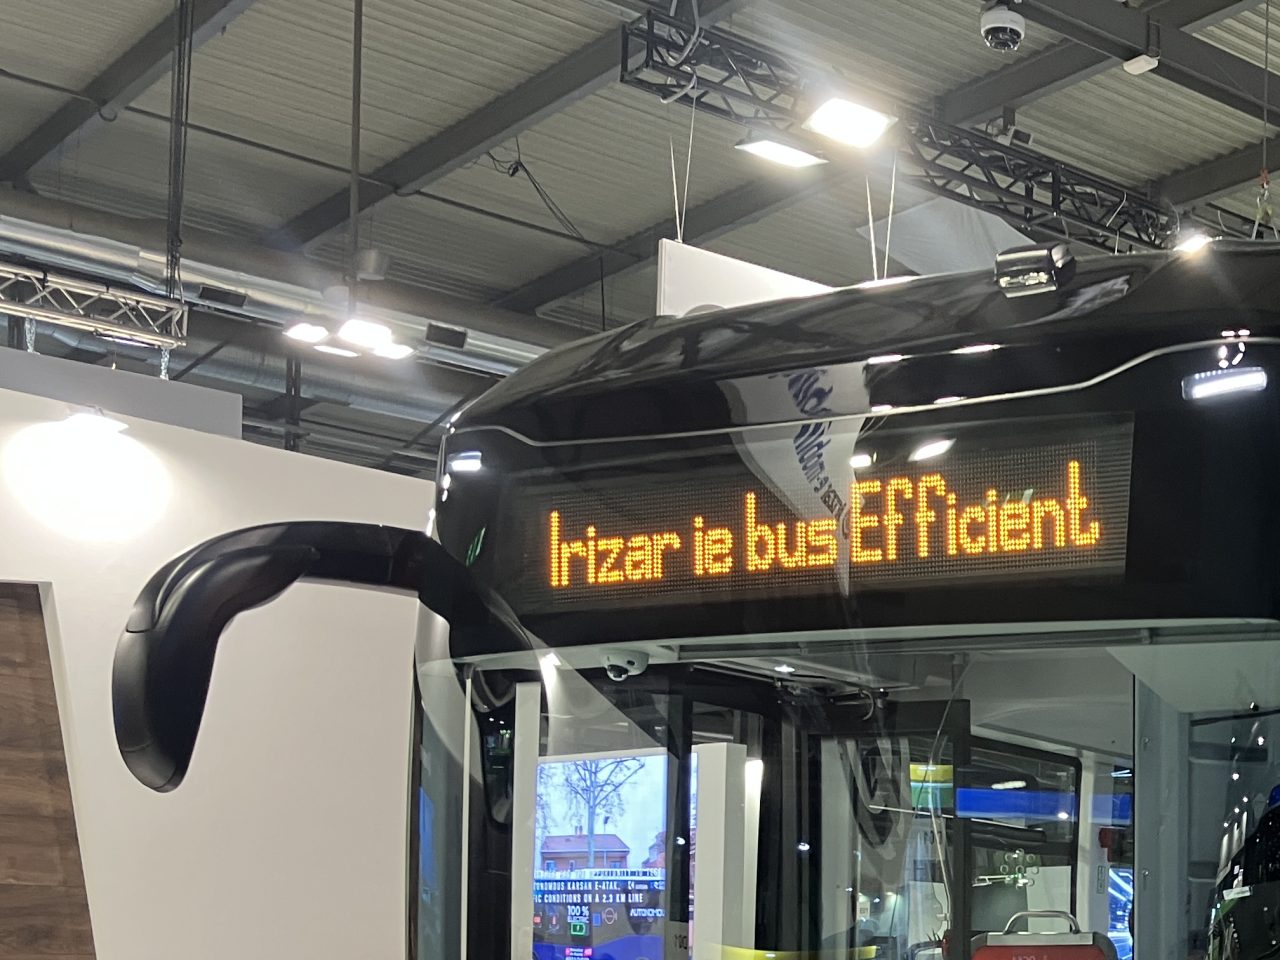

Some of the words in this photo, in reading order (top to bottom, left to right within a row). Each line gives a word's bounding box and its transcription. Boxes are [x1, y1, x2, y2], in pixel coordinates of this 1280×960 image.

[549, 509, 681, 587] Irizar
[693, 515, 734, 576] ie
[745, 490, 838, 572] bus
[849, 459, 1101, 564] Efficient
[567, 881, 593, 890] KARSAN
[544, 893, 581, 903] CONDITIONS
[583, 893, 593, 903] ON
[628, 893, 644, 903] LINE
[567, 905, 580, 916] 100
